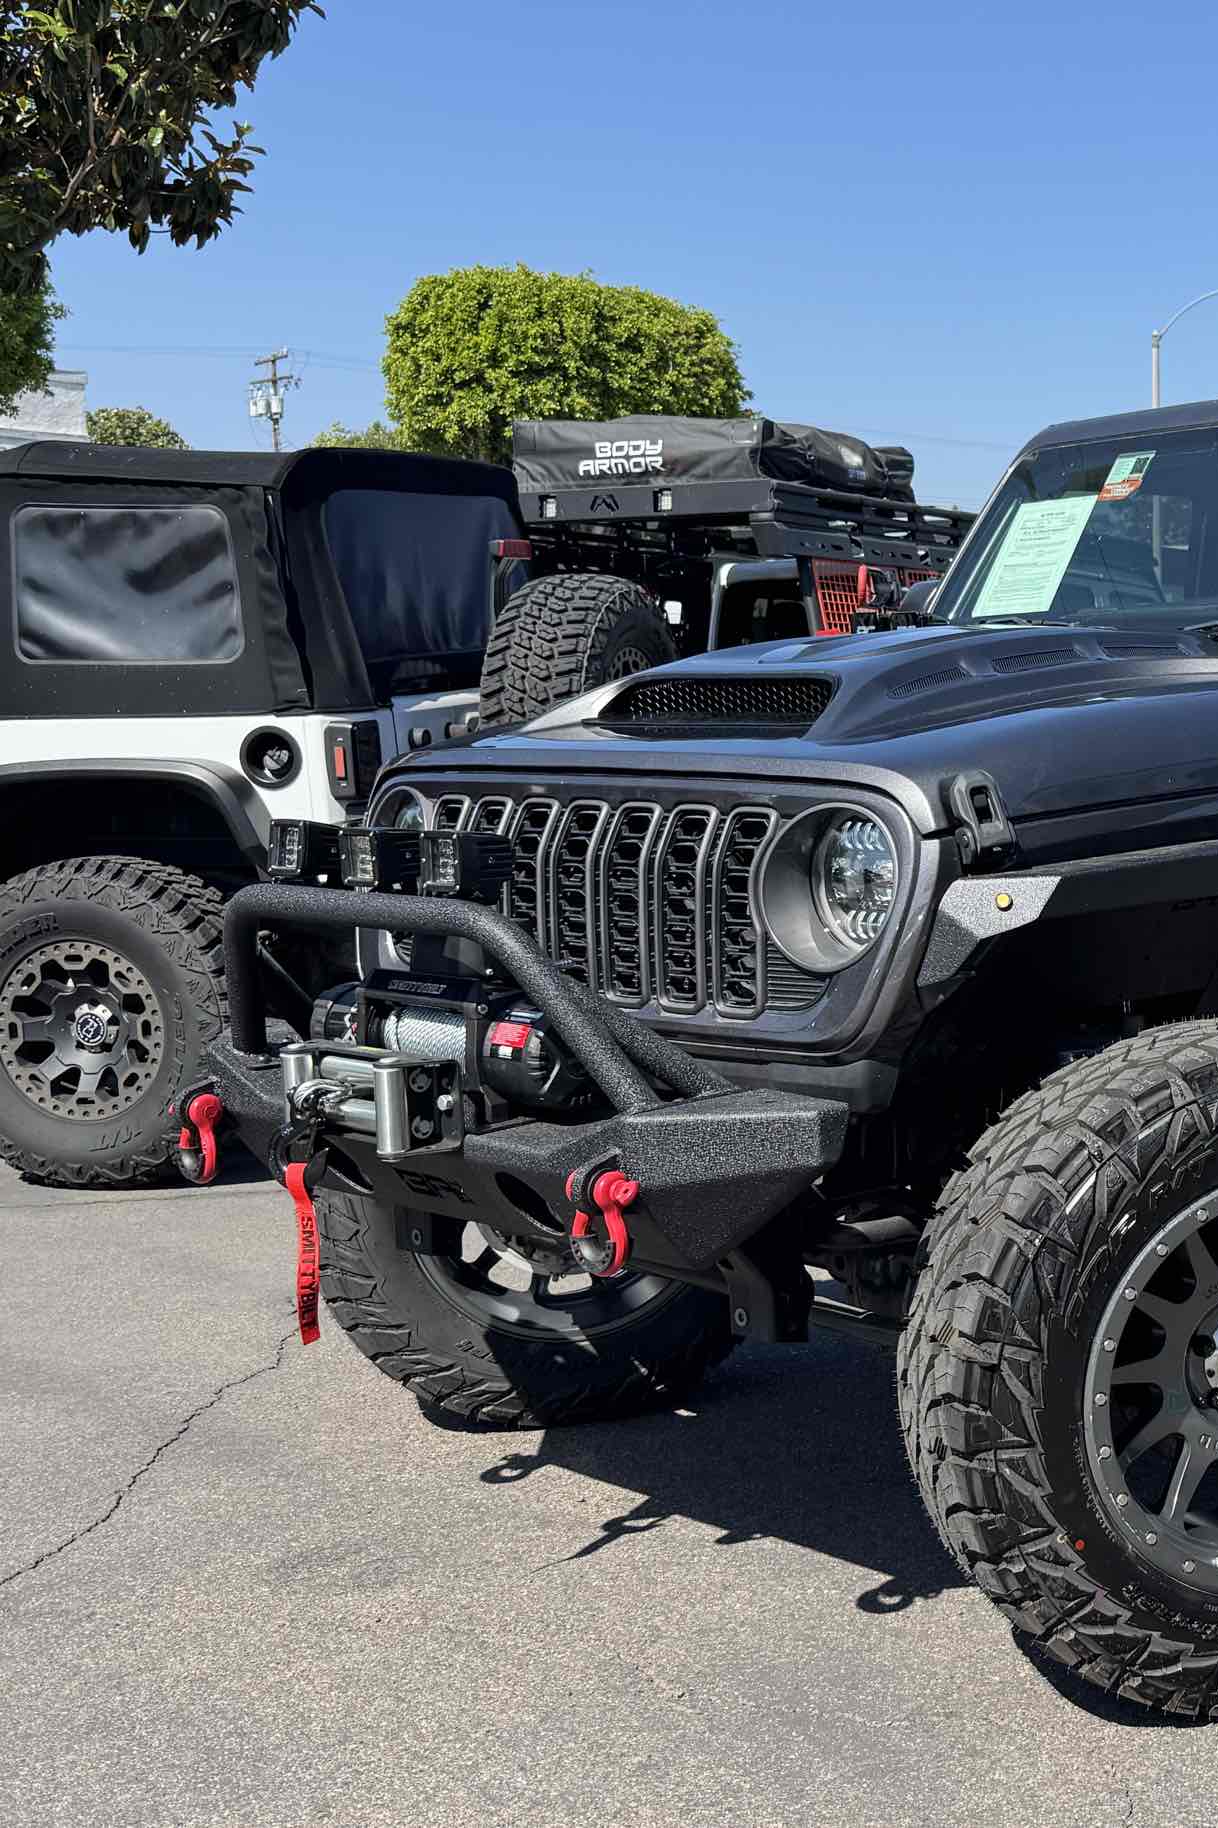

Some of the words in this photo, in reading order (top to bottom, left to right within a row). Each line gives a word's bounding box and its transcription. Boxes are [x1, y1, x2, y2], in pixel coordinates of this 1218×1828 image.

[595, 440, 663, 458] BODY
[579, 456, 666, 476] ARMOR
[301, 1215, 319, 1330] SMITTYBILT
